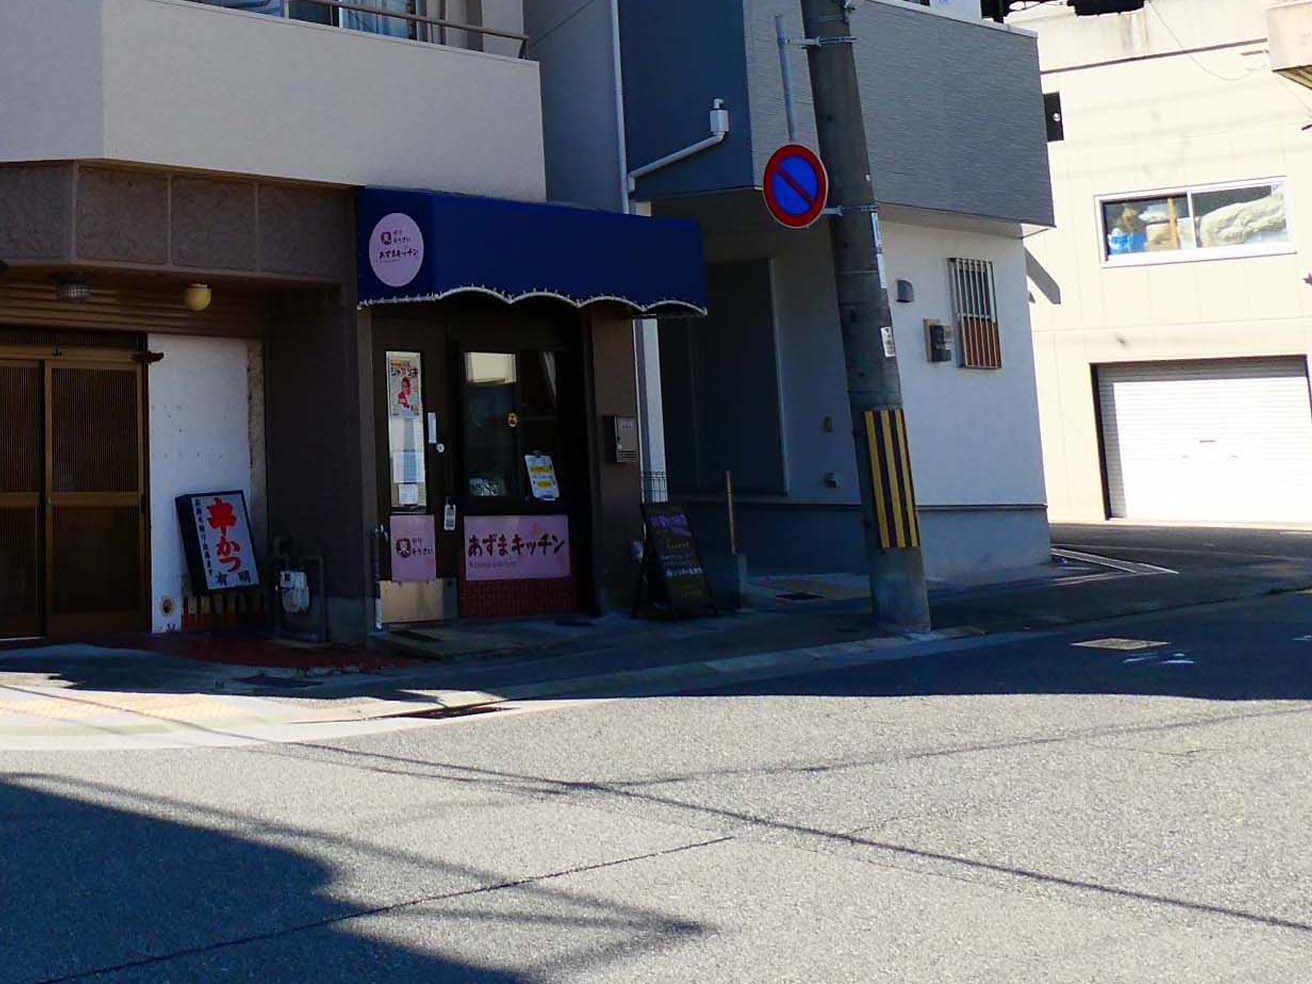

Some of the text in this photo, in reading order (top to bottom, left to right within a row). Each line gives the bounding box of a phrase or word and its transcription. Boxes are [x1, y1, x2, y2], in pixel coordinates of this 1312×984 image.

[206, 497, 241, 573] 串かつ
[467, 532, 566, 557] あずまキッチン
